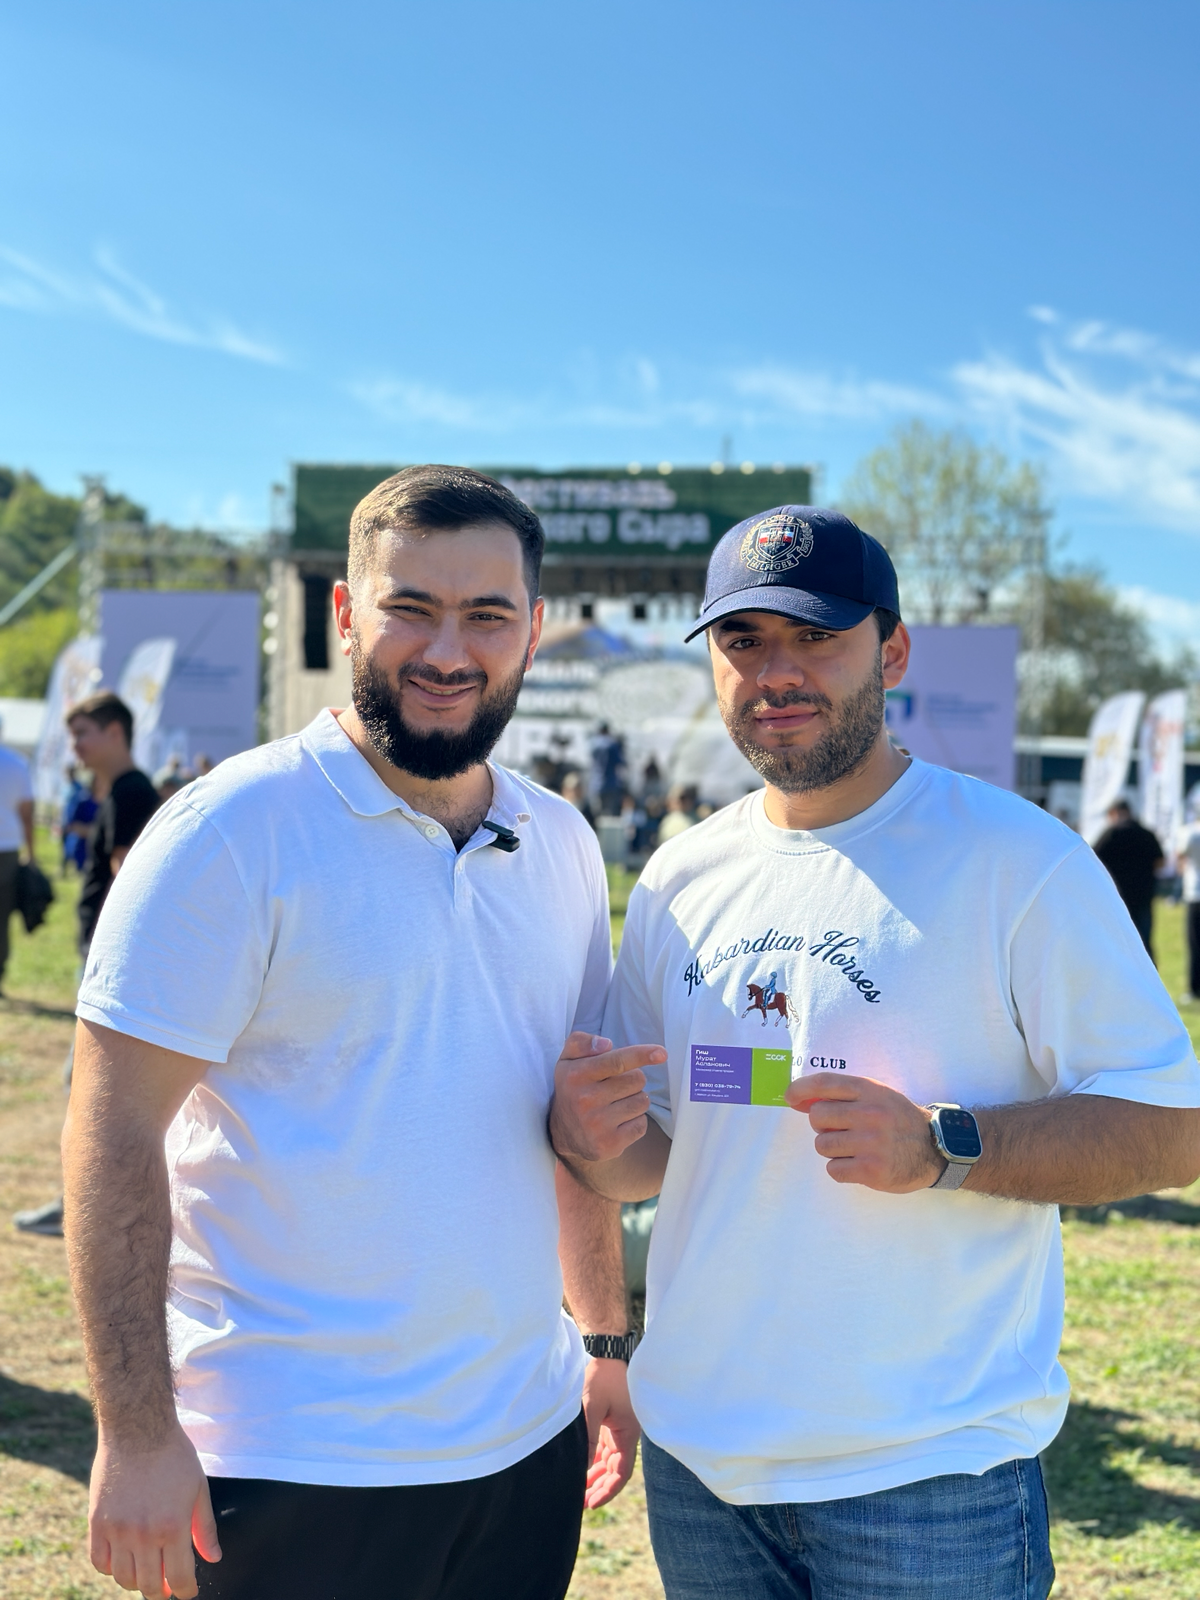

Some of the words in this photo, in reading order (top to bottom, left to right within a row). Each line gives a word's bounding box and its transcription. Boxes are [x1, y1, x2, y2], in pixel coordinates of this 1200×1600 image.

[683, 928, 806, 997] Kabardian
[809, 930, 881, 1003] Horses
[810, 1056, 847, 1070] CLUB
